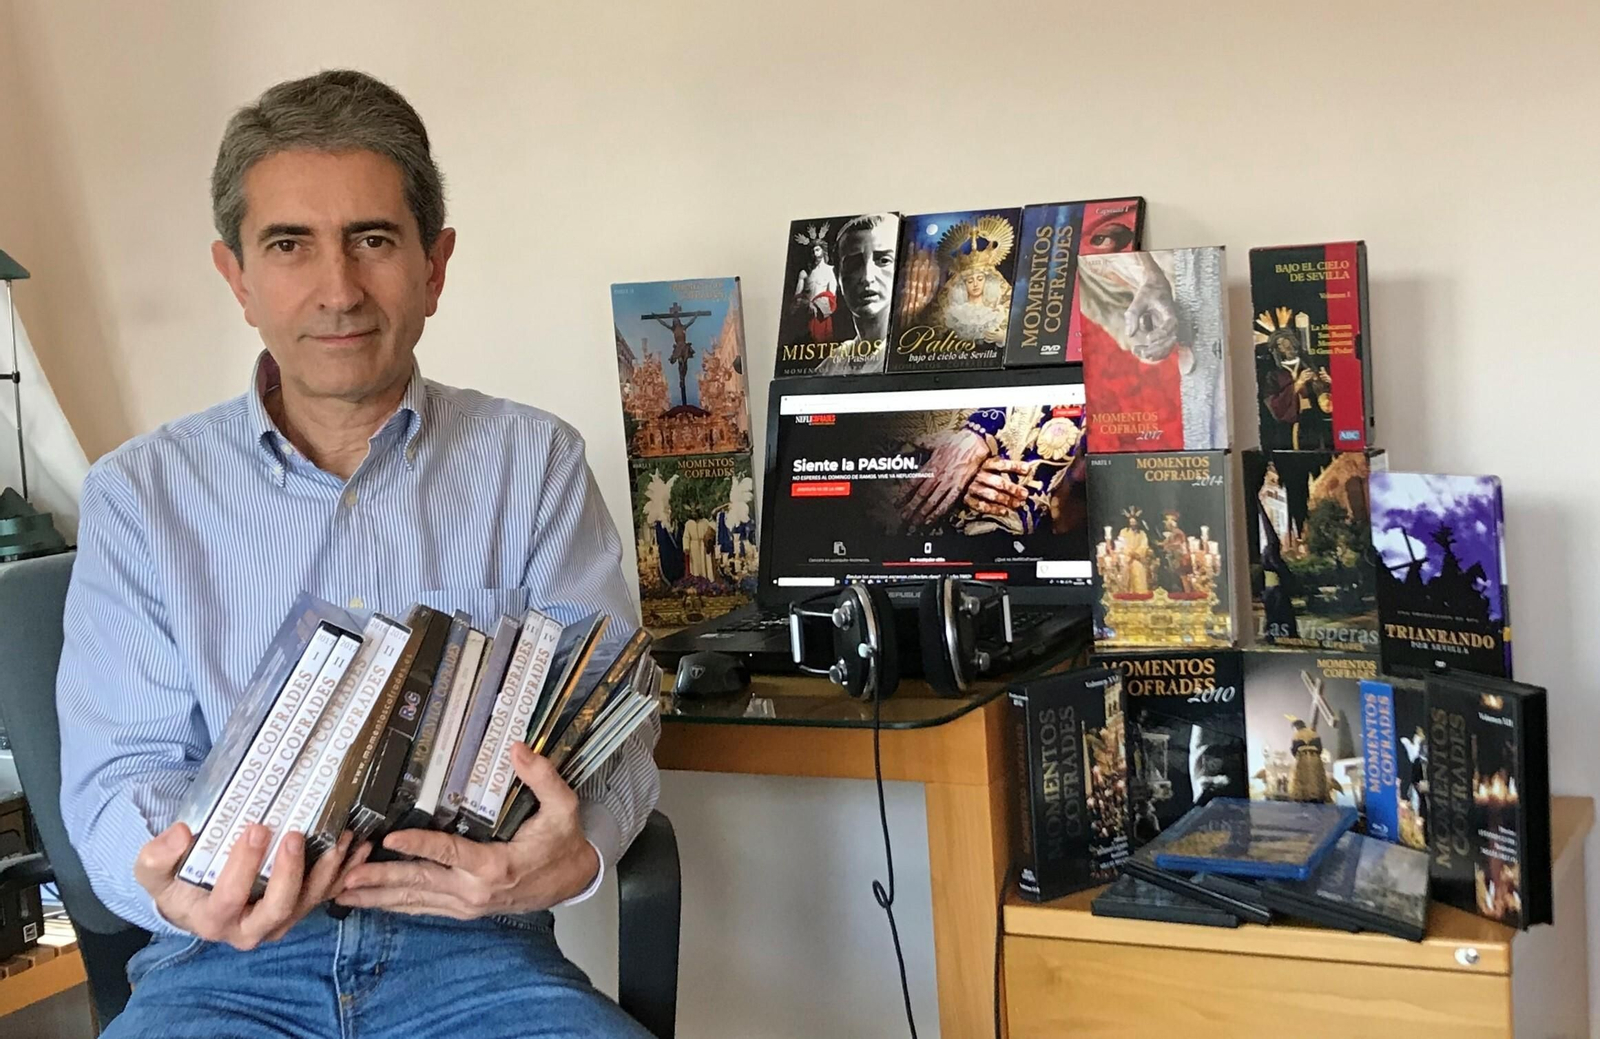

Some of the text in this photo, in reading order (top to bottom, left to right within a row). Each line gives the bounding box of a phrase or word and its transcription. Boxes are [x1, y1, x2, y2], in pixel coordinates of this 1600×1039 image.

[1275, 260, 1349, 273] BAJO EL CIELO
[1044, 224, 1073, 333] COFRADES
[1290, 271, 1350, 282] DE SEVILLA
[1021, 225, 1054, 348] MOMENTOS
[897, 325, 977, 354] Palios
[908, 349, 998, 363] bajo el cielo de Sevilla
[1092, 412, 1158, 423] MOMENTOS
[1100, 423, 1159, 434] COFRADES
[1136, 430, 1164, 440] 2017
[678, 457, 735, 469] MOMENTOS
[793, 453, 918, 472] Siente la PASIÓN.
[1136, 456, 1210, 469] MOMENTOS
[685, 467, 735, 479] COFRADES
[1145, 469, 1210, 482] COFRADES
[1191, 475, 1223, 487] 2014
[1257, 616, 1290, 637] Las
[543, 633, 556, 643] IV
[1411, 640, 1470, 654] POR SEVILLA
[383, 645, 395, 657] II
[1317, 659, 1377, 670] MOMENTOS
[520, 647, 551, 716] COFRADES
[1128, 677, 1216, 697] OFRADES
[1187, 686, 1236, 704] 2010
[282, 675, 336, 764] COFRADES
[470, 638, 534, 788] MOMENTOS COFRADES
[264, 659, 367, 837] OMENTOS COFRADES
[288, 664, 387, 833] OMENTOS COFRADES
[1364, 692, 1382, 793] MOMENTOS
[1377, 694, 1395, 786] COFRADES
[200, 669, 313, 855] MOMENTOS COFRADES
[1058, 704, 1082, 838] COFRADES
[1430, 706, 1453, 869] MOMENTOS
[1449, 714, 1470, 856] COFRADES
